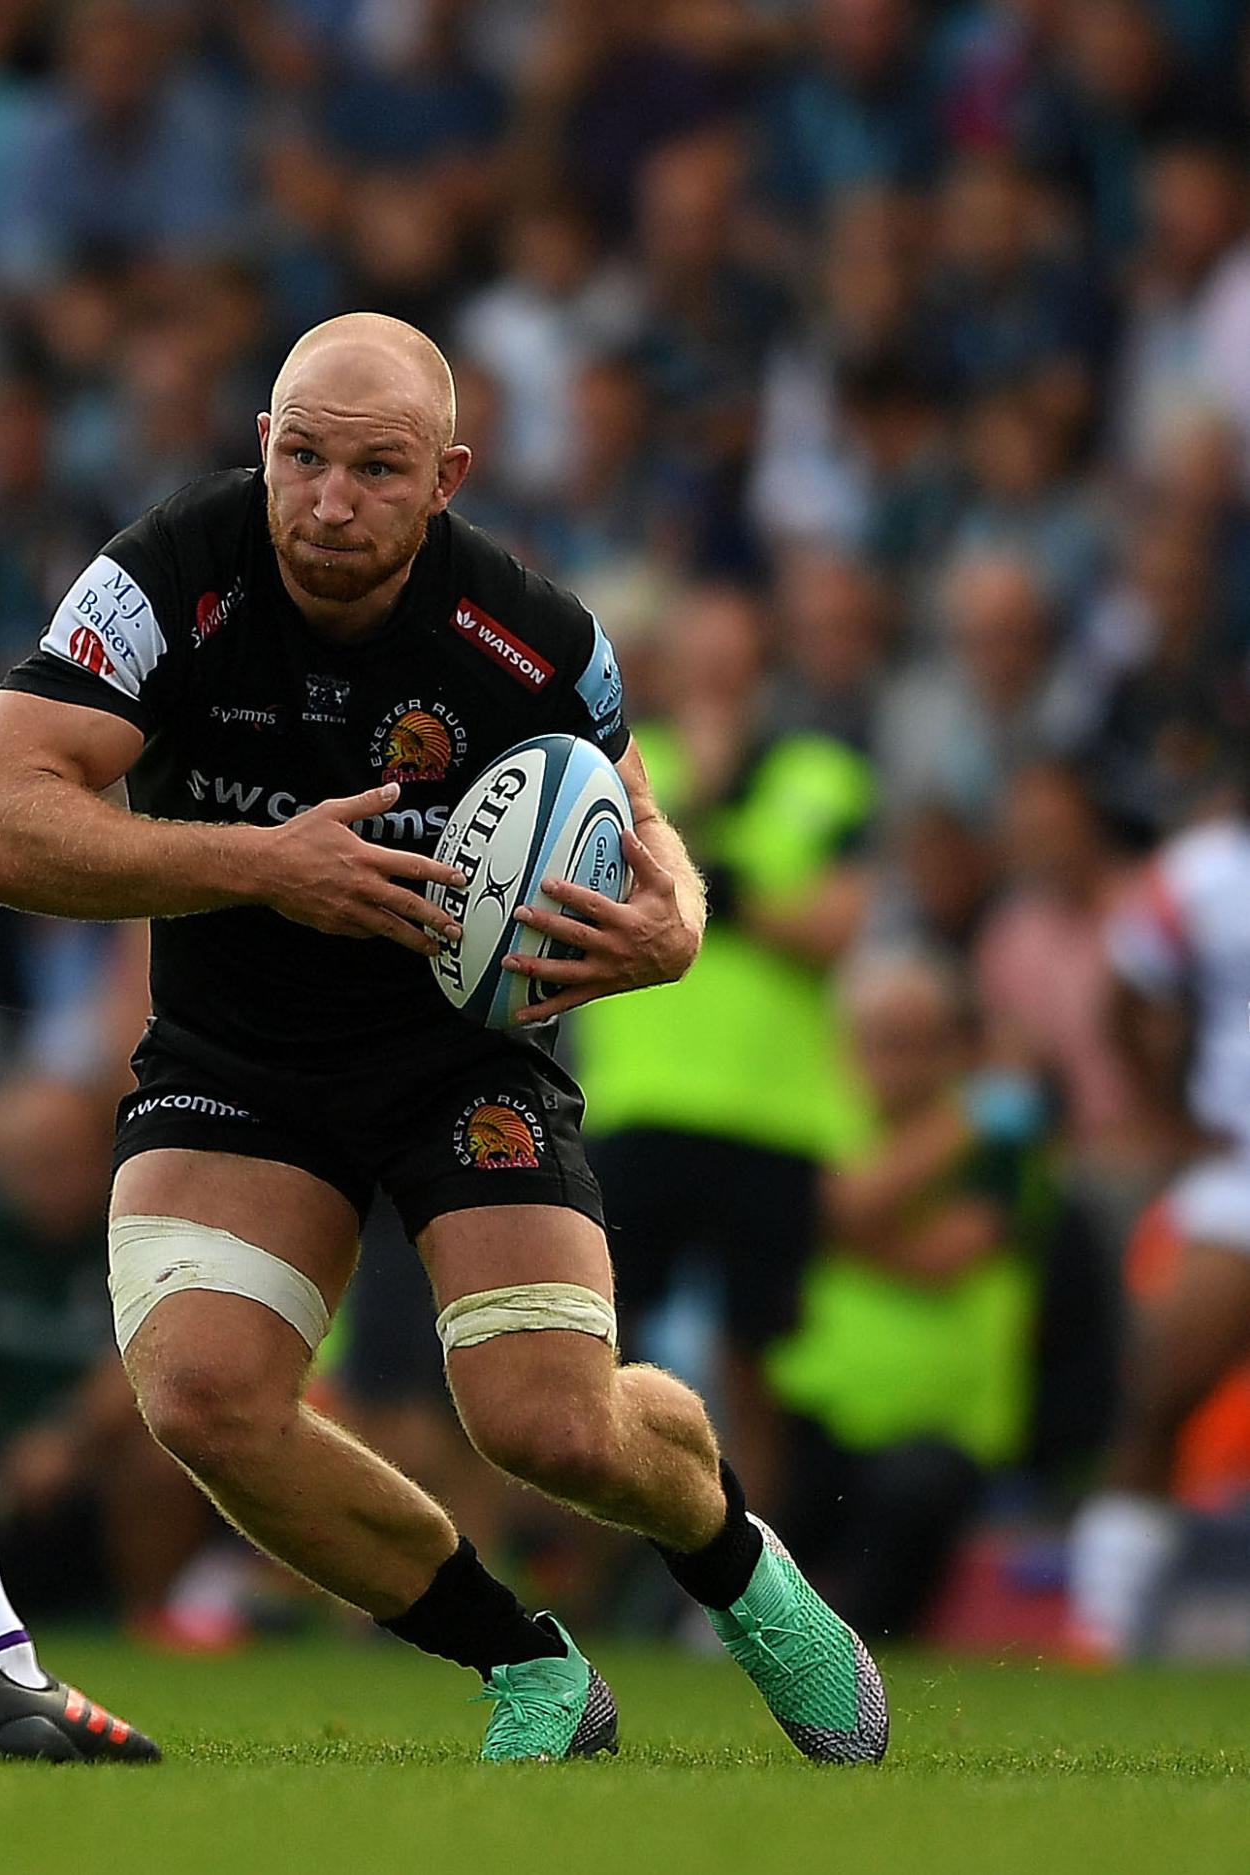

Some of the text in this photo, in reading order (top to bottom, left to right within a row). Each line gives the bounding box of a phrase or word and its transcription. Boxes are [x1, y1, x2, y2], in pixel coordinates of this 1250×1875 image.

[76, 588, 135, 663] Baker
[102, 571, 149, 630] M.J.
[477, 624, 546, 685] WATSON
[369, 698, 468, 768] EXETER RUGBY
[453, 1095, 486, 1166] EXETER
